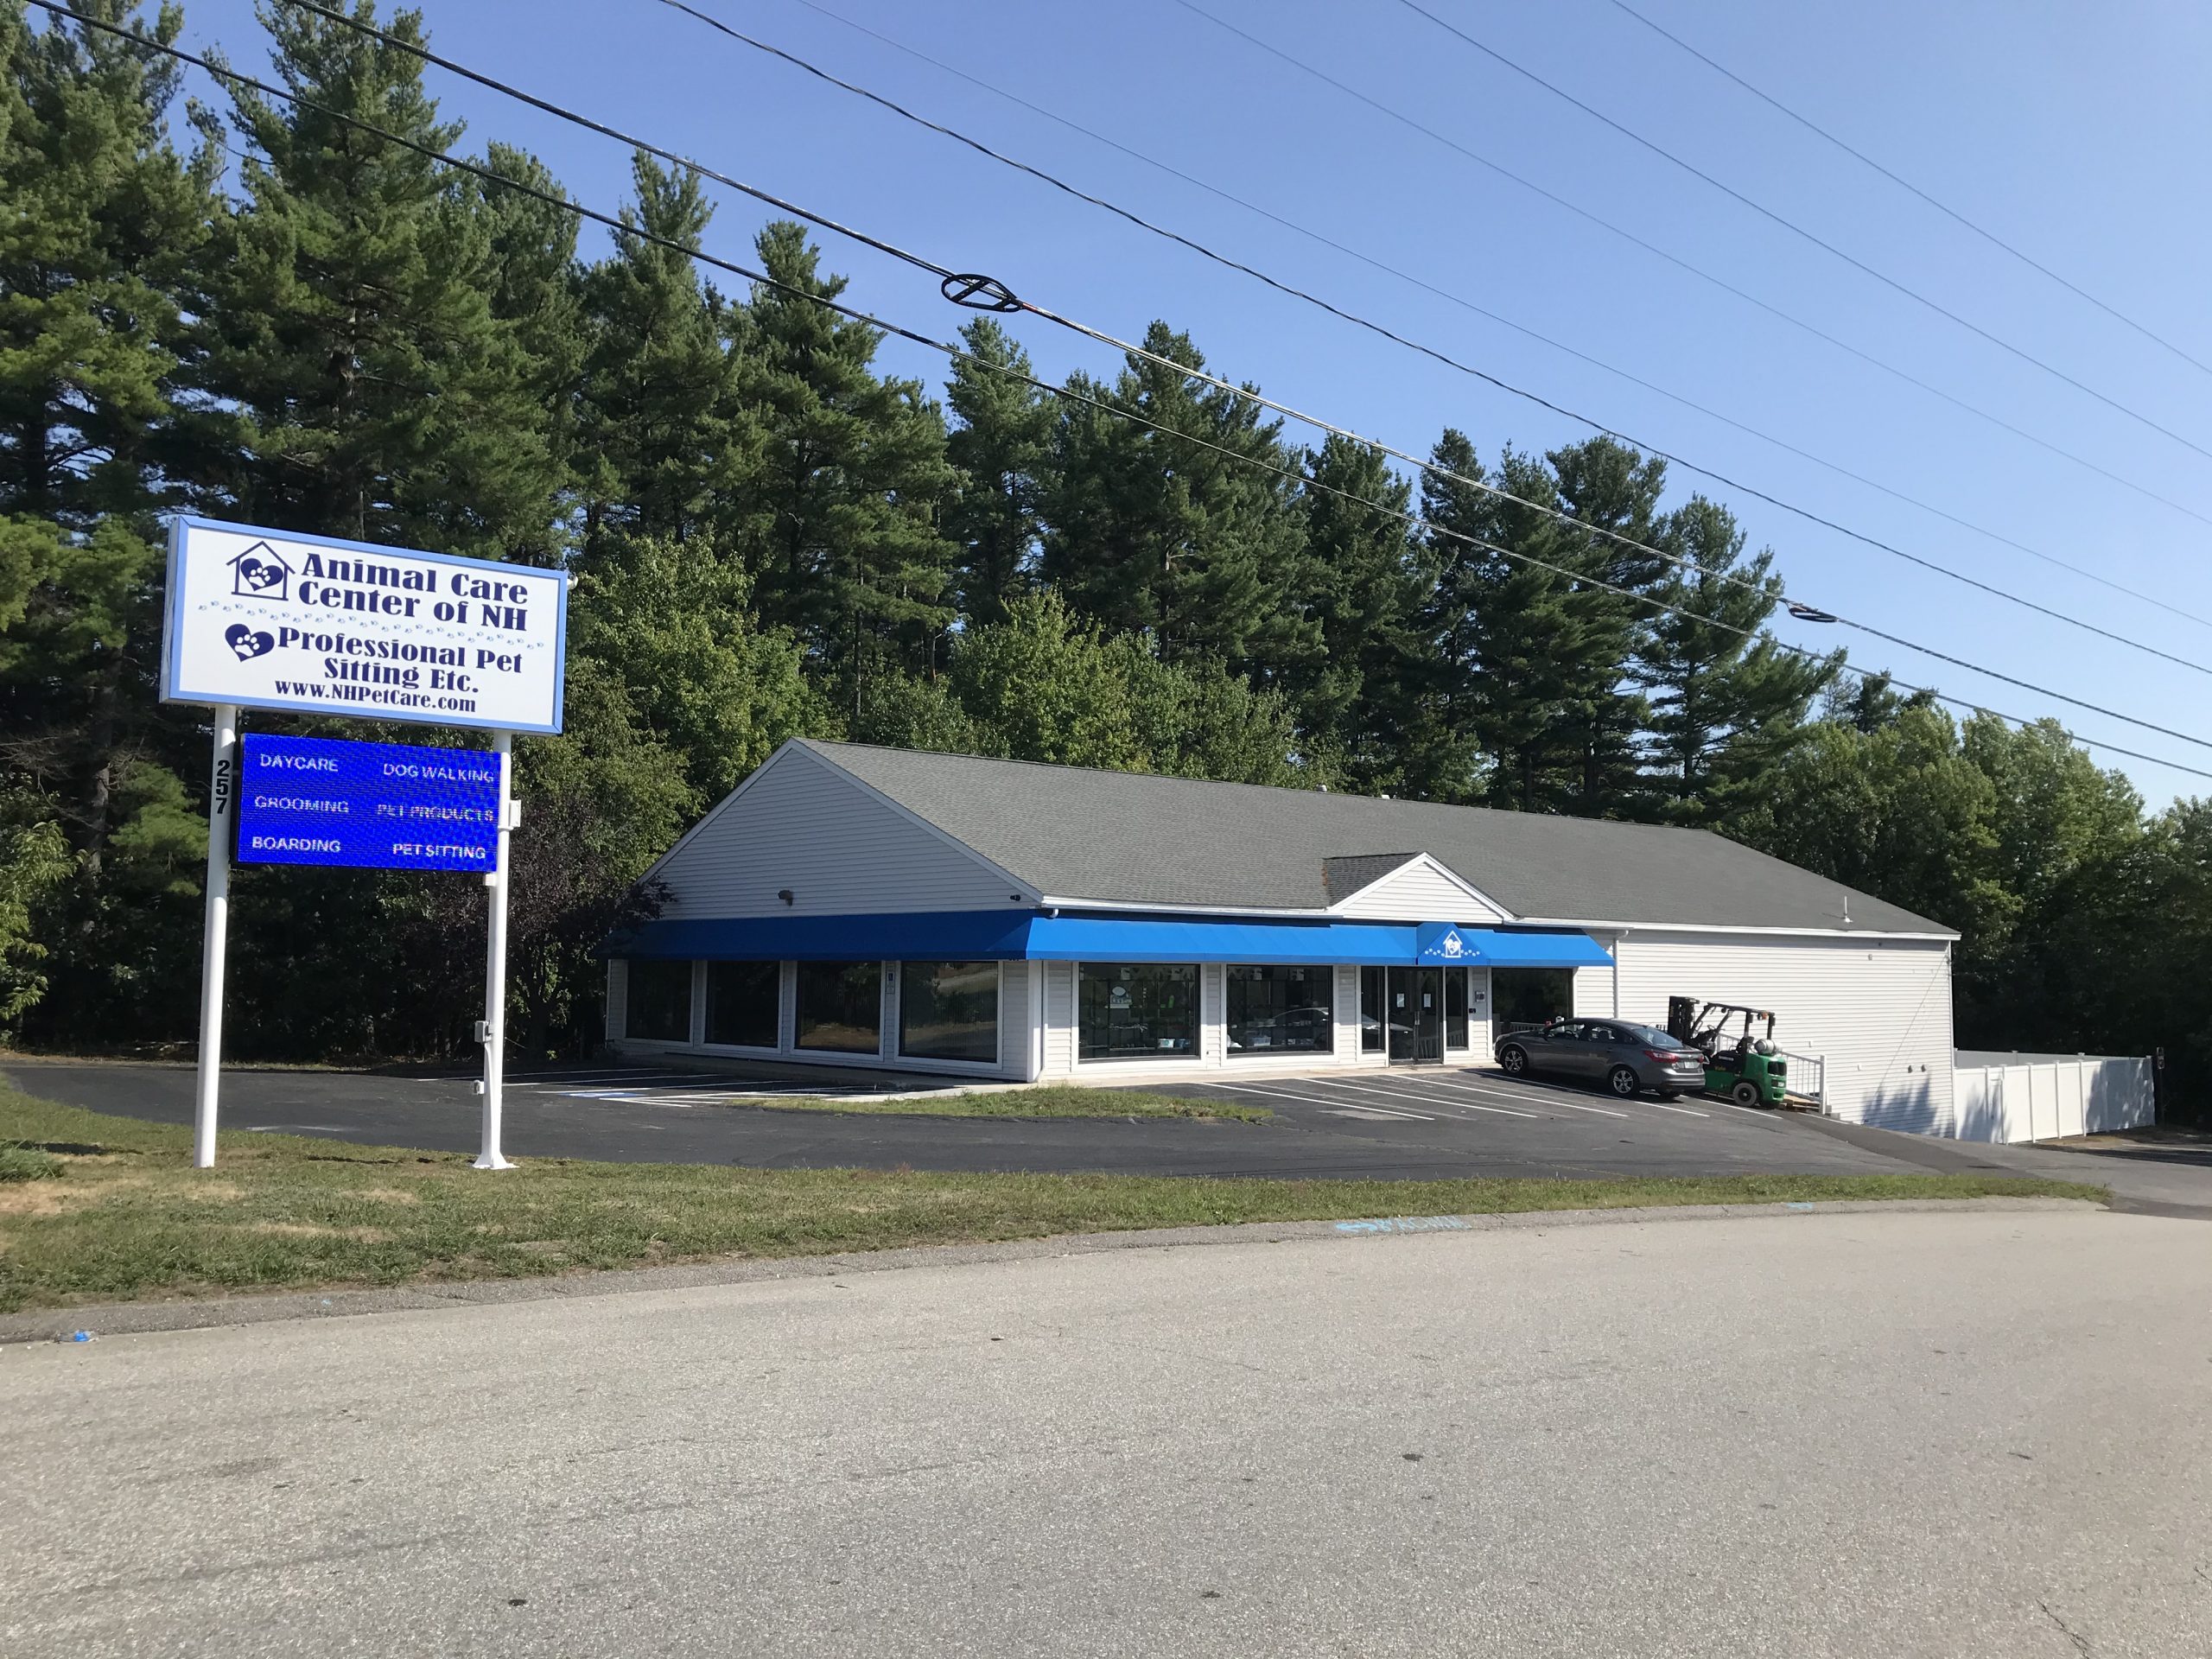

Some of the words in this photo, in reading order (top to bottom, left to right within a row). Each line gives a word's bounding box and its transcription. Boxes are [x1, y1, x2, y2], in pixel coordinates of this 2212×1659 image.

[301, 552, 436, 593] Animal
[451, 573, 528, 605] Care
[298, 581, 421, 617] Center
[434, 601, 469, 624] of
[480, 604, 528, 632] NH
[278, 626, 466, 667] Professional
[476, 648, 523, 673] Pet
[324, 658, 419, 690] Sitting
[429, 668, 479, 693] Etc.
[275, 680, 476, 713] www.NHPetCare.com
[260, 753, 339, 772] DAYCARE
[383, 763, 418, 778] DOG
[422, 766, 494, 783] WALKING
[215, 760, 231, 815] 257
[254, 795, 349, 813] GROOMING
[251, 836, 341, 853] BOARDING
[392, 843, 423, 855] PET
[426, 844, 486, 860] SITTING
